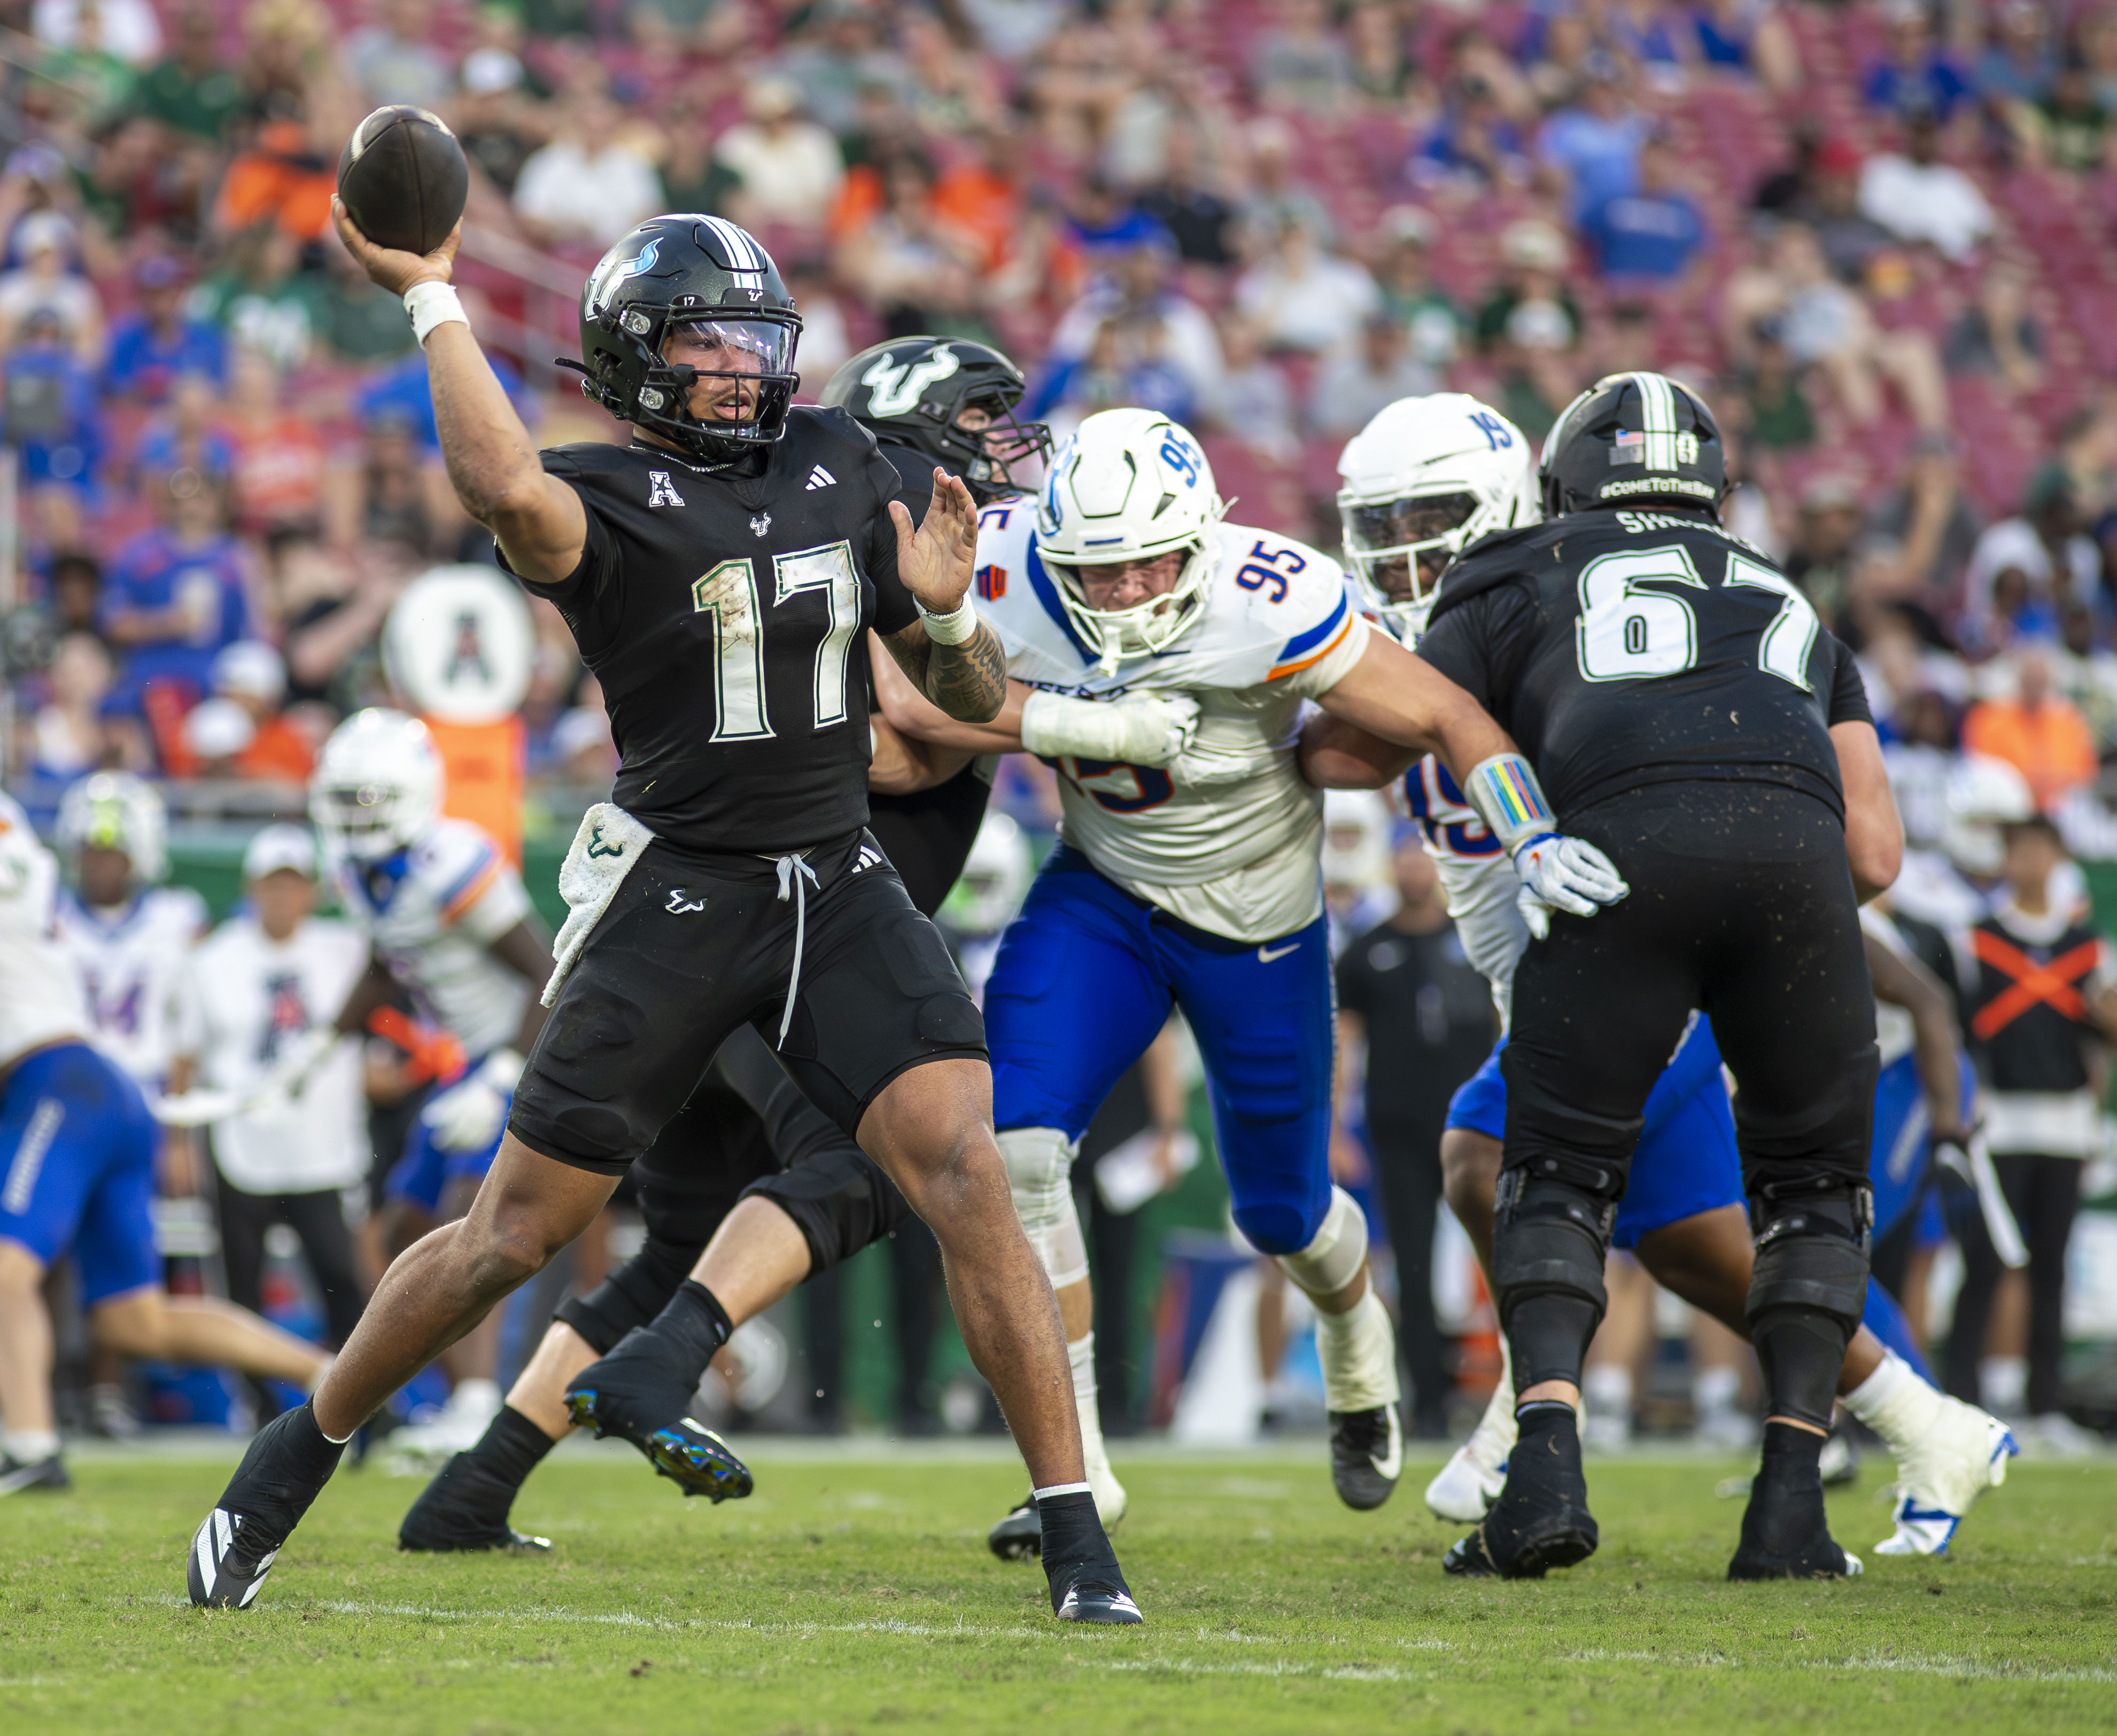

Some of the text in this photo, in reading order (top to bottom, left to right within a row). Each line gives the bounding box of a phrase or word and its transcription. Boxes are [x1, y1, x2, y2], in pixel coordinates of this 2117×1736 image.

[684, 297, 695, 306] 17
[1160, 428, 1201, 487] 95
[1468, 412, 1512, 450] 19
[649, 471, 685, 507] A
[1234, 539, 1307, 605] 95
[691, 539, 862, 743] 17
[1576, 544, 1819, 692] 67
